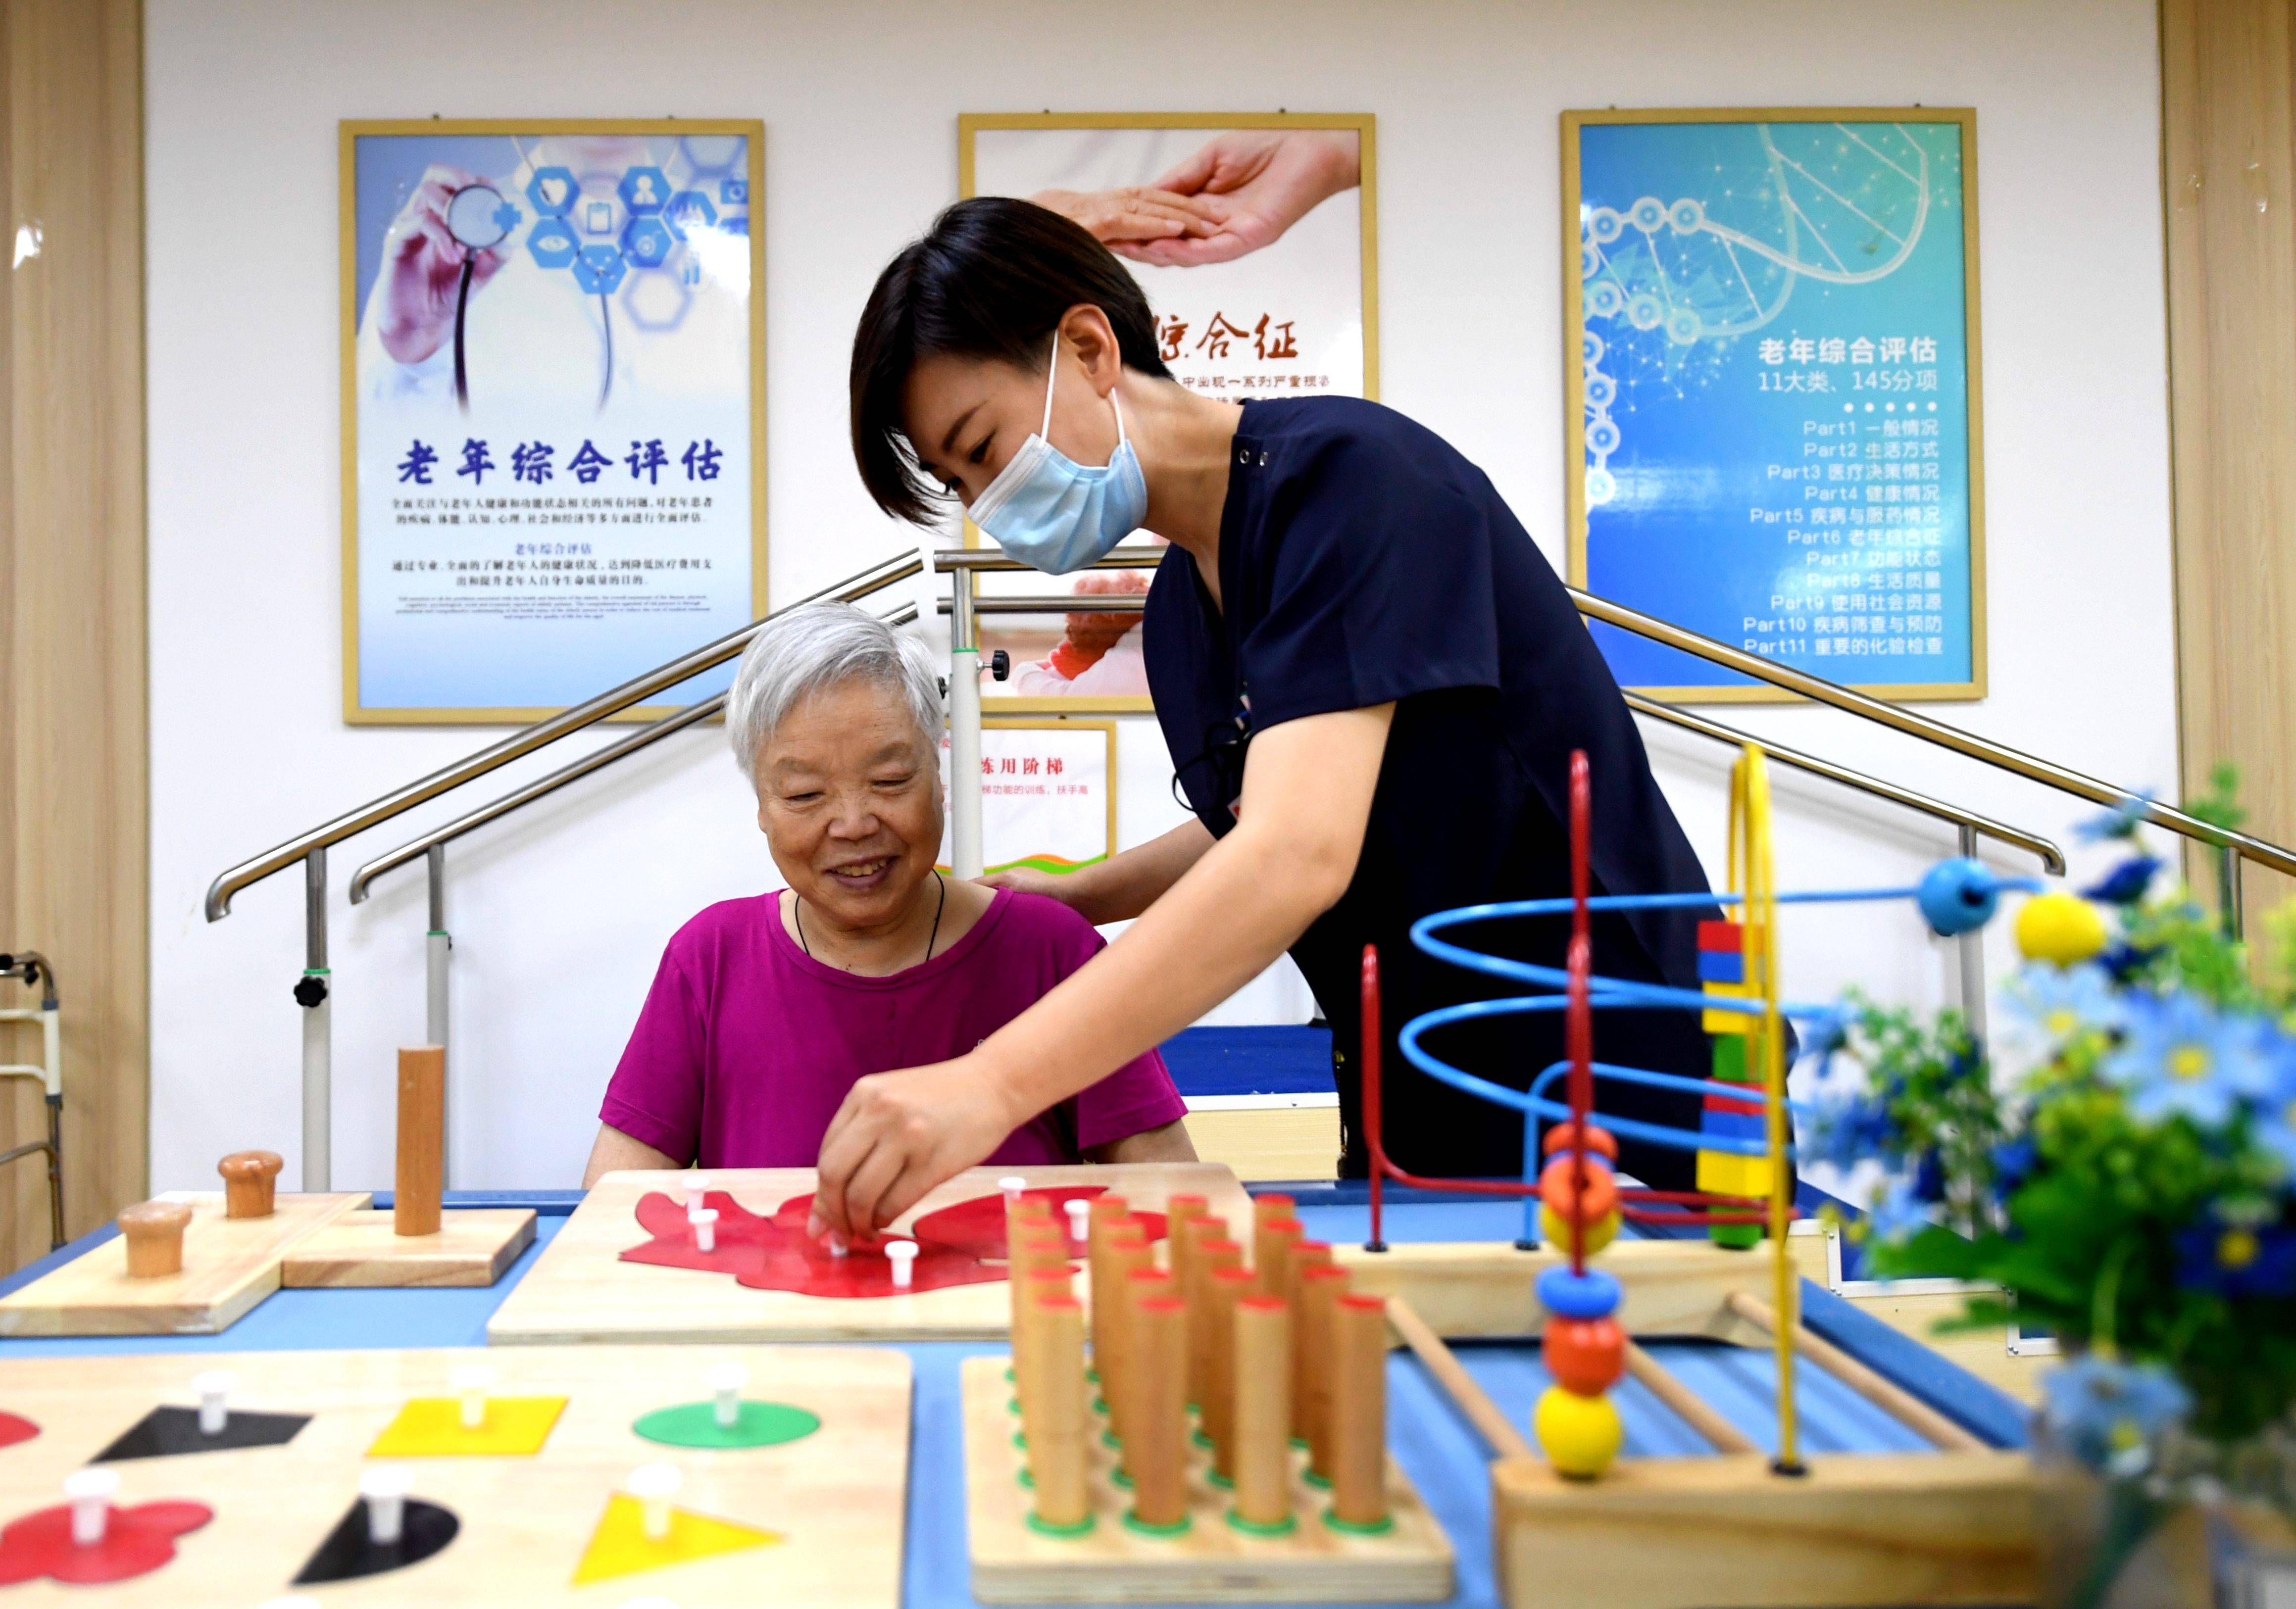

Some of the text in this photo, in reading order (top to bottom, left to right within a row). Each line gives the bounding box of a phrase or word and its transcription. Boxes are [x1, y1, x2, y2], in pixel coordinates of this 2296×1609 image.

[1758, 337, 1938, 365] 老年综合评估
[1758, 369, 1938, 393] 11大类、145分项
[1803, 418, 1939, 437] Part1 一般情况
[1803, 441, 1939, 459] Part2 生活方式
[398, 439, 724, 485] 老年综合评估
[1767, 463, 1940, 481] Part3 医疗决策情况
[1805, 485, 1940, 502] Part4 健康情况
[1750, 506, 1941, 525] Part5 疾病与服药情况
[1788, 529, 1841, 544] Part6
[515, 543, 592, 556] 老年综合评估
[1807, 550, 1941, 567] Part7 功能状态
[1807, 571, 1941, 589] Part8 生活质量
[1770, 593, 1942, 612] Part9 使用社会资源
[1743, 616, 1942, 634] Part10 疾病筛查与预防
[1744, 637, 1943, 656] Part11 重要的化验检查
